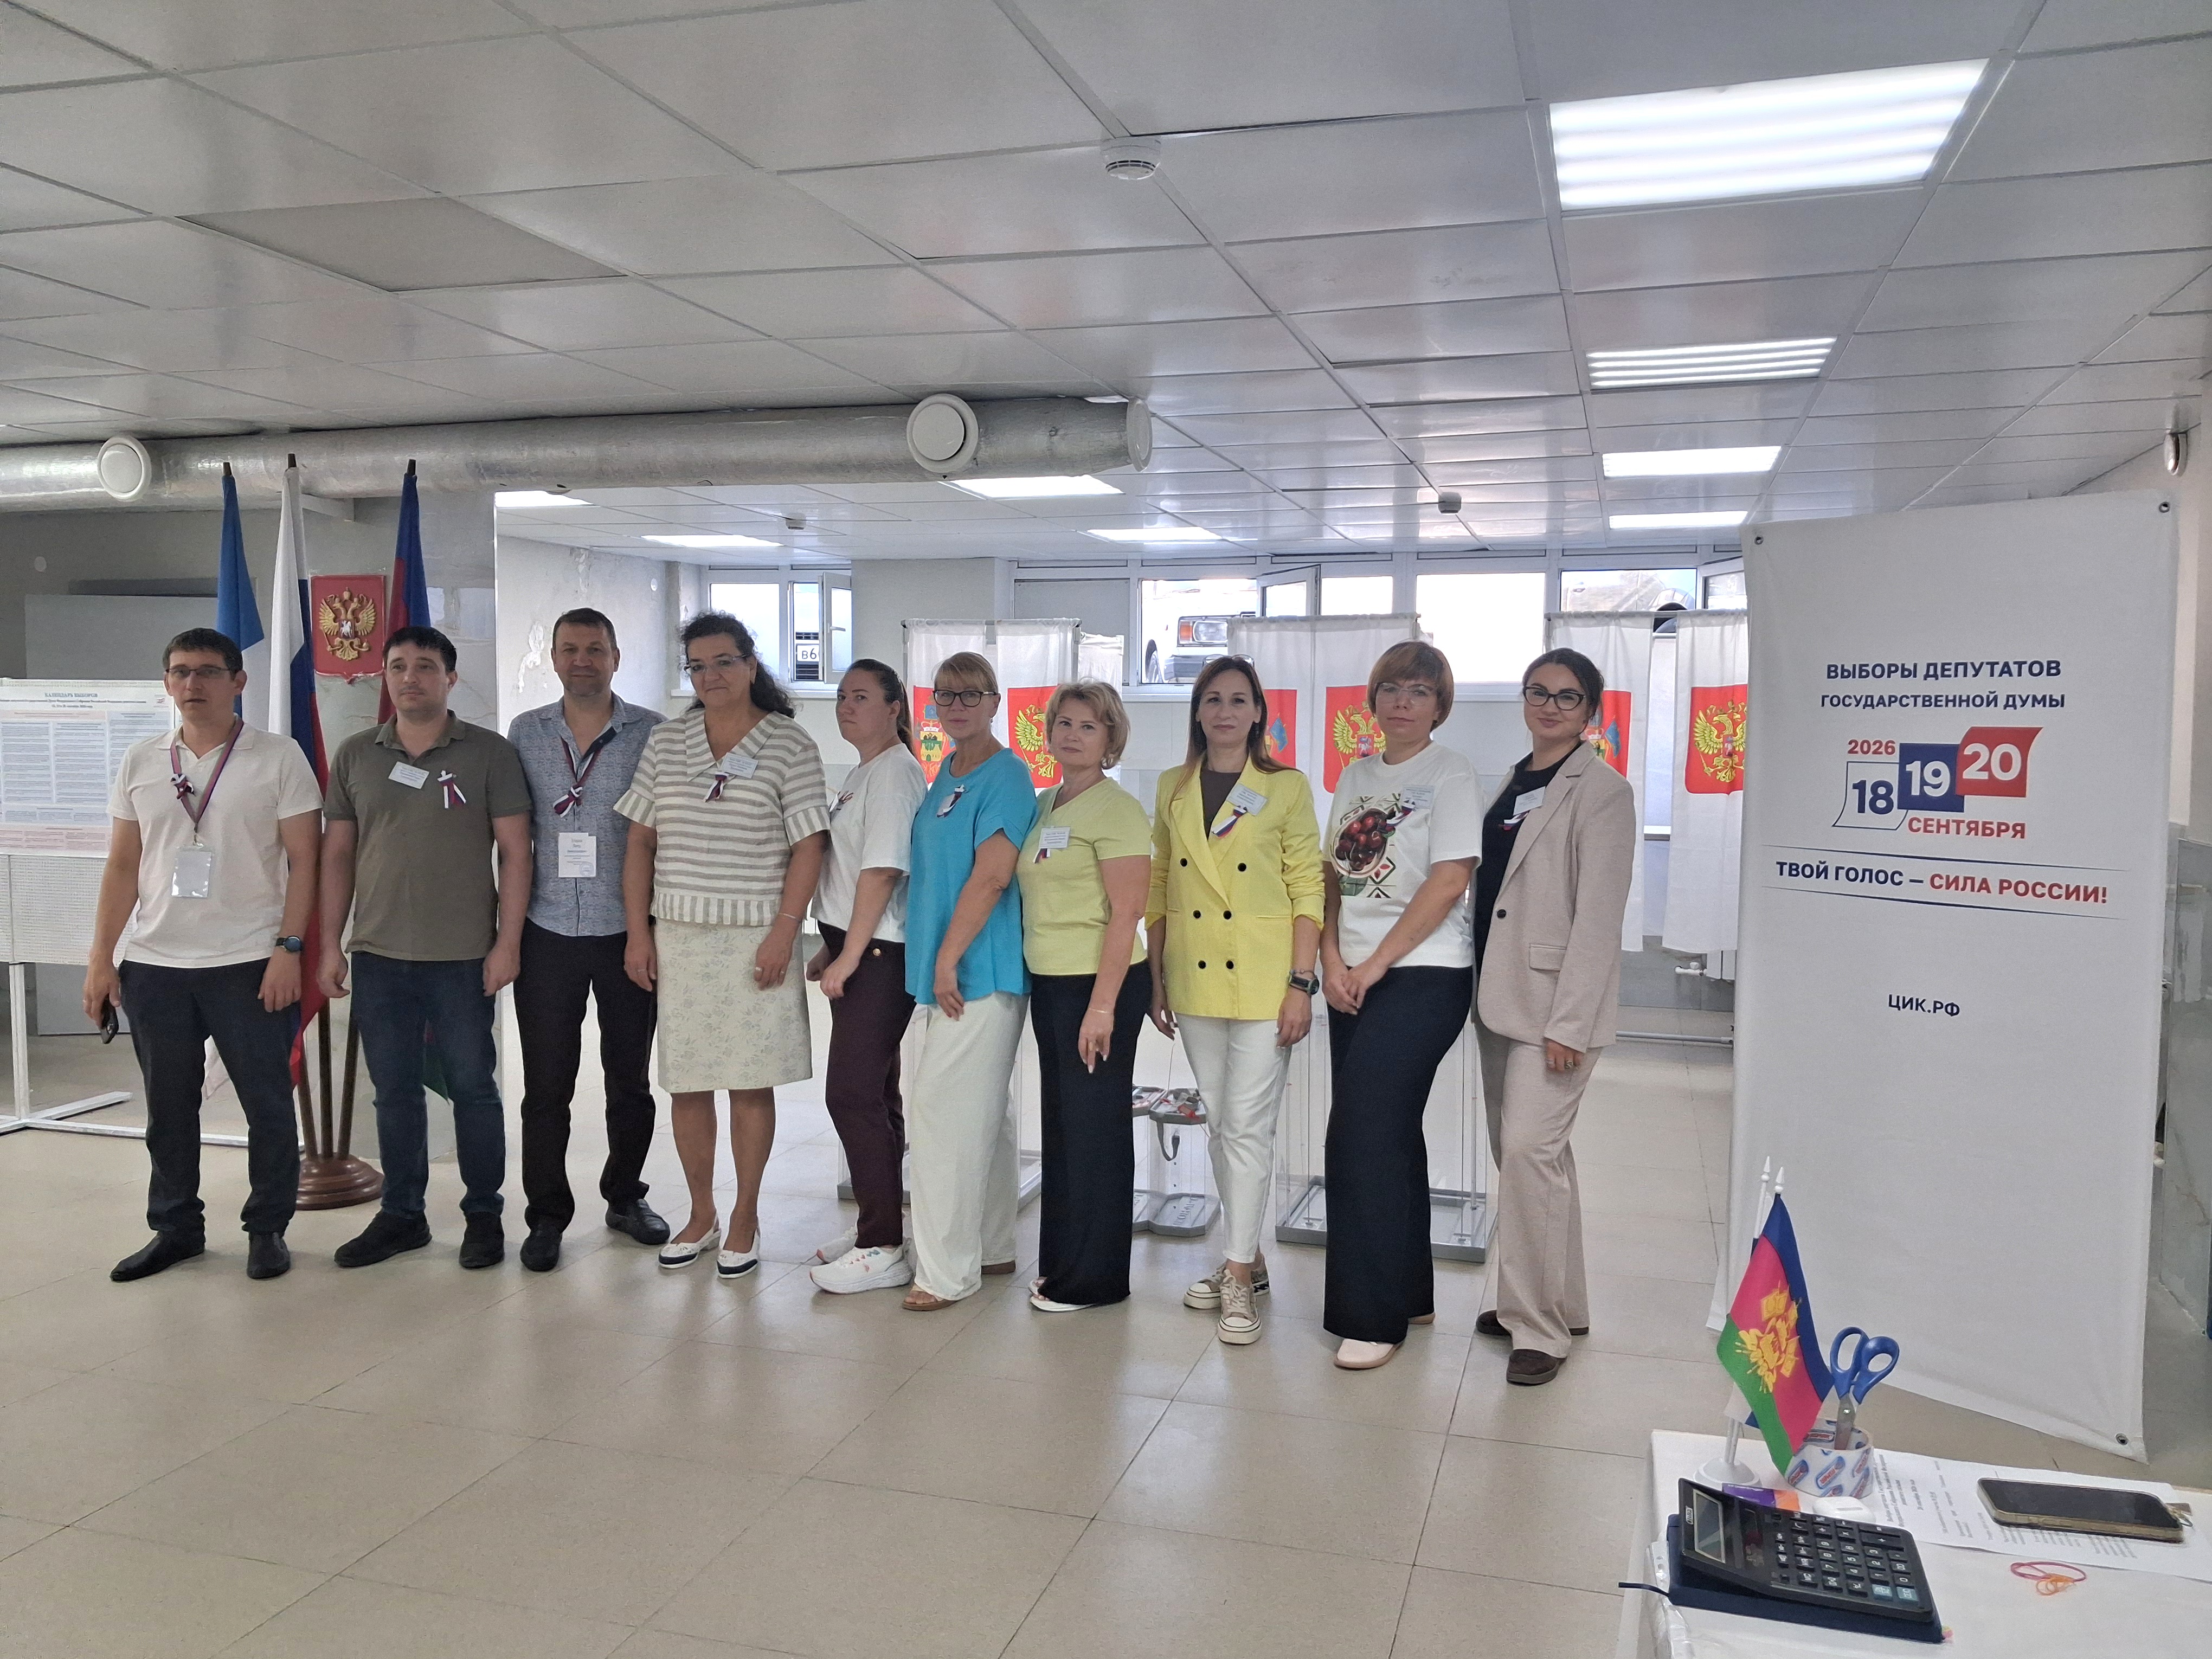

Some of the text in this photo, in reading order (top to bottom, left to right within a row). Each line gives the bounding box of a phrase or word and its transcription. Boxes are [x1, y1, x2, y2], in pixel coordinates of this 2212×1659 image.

[1827, 660, 2061, 681] ВЫБОРЫ ДЕПУТАТОВ
[1821, 691, 2065, 710] ГОСУДАРСТВЕННОЙ ДУМЫ
[1847, 739, 1896, 755] 2026
[1962, 743, 2022, 781] 20
[1905, 760, 1951, 798] 19
[1852, 779, 1894, 815] 18
[1907, 816, 2026, 839] СЕНТЯБРЯ
[1776, 860, 1829, 880] ТВОЙ
[1835, 865, 1904, 886] ГОЛОС
[1930, 873, 1992, 895] СИЛА
[1998, 878, 2107, 904] РОССИИ!
[1888, 994, 1960, 1017] ЦИК.РФ
